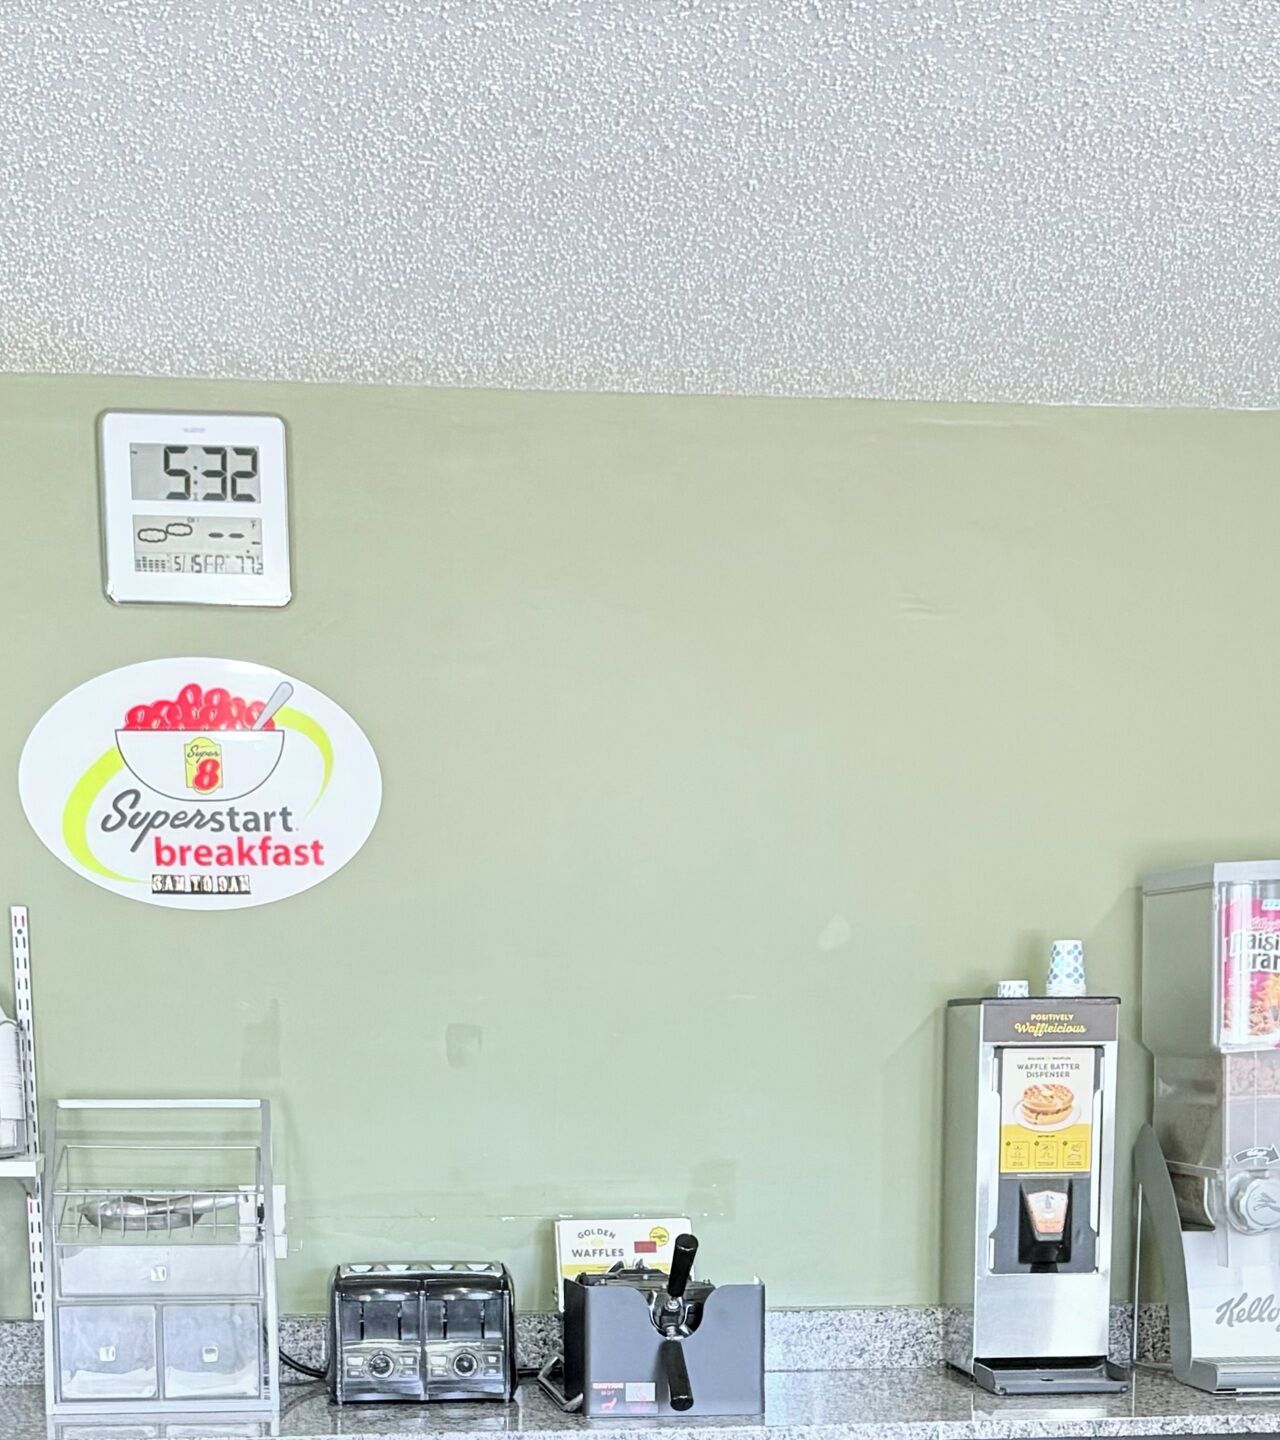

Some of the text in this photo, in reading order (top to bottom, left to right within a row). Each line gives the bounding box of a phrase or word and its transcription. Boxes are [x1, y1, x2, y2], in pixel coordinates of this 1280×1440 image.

[163, 445, 258, 502] 5:32
[186, 744, 220, 764] Super
[193, 757, 221, 792] 8
[100, 788, 294, 853] Superstart
[154, 835, 325, 867] breakfast
[1030, 1013, 1075, 1022] POSITIVELY
[1016, 1063, 1081, 1071] WAFFLE BATTER
[1026, 1070, 1071, 1079] DISPENSER
[577, 1227, 617, 1240] GOLDEN
[571, 1248, 625, 1259] WAFFLES
